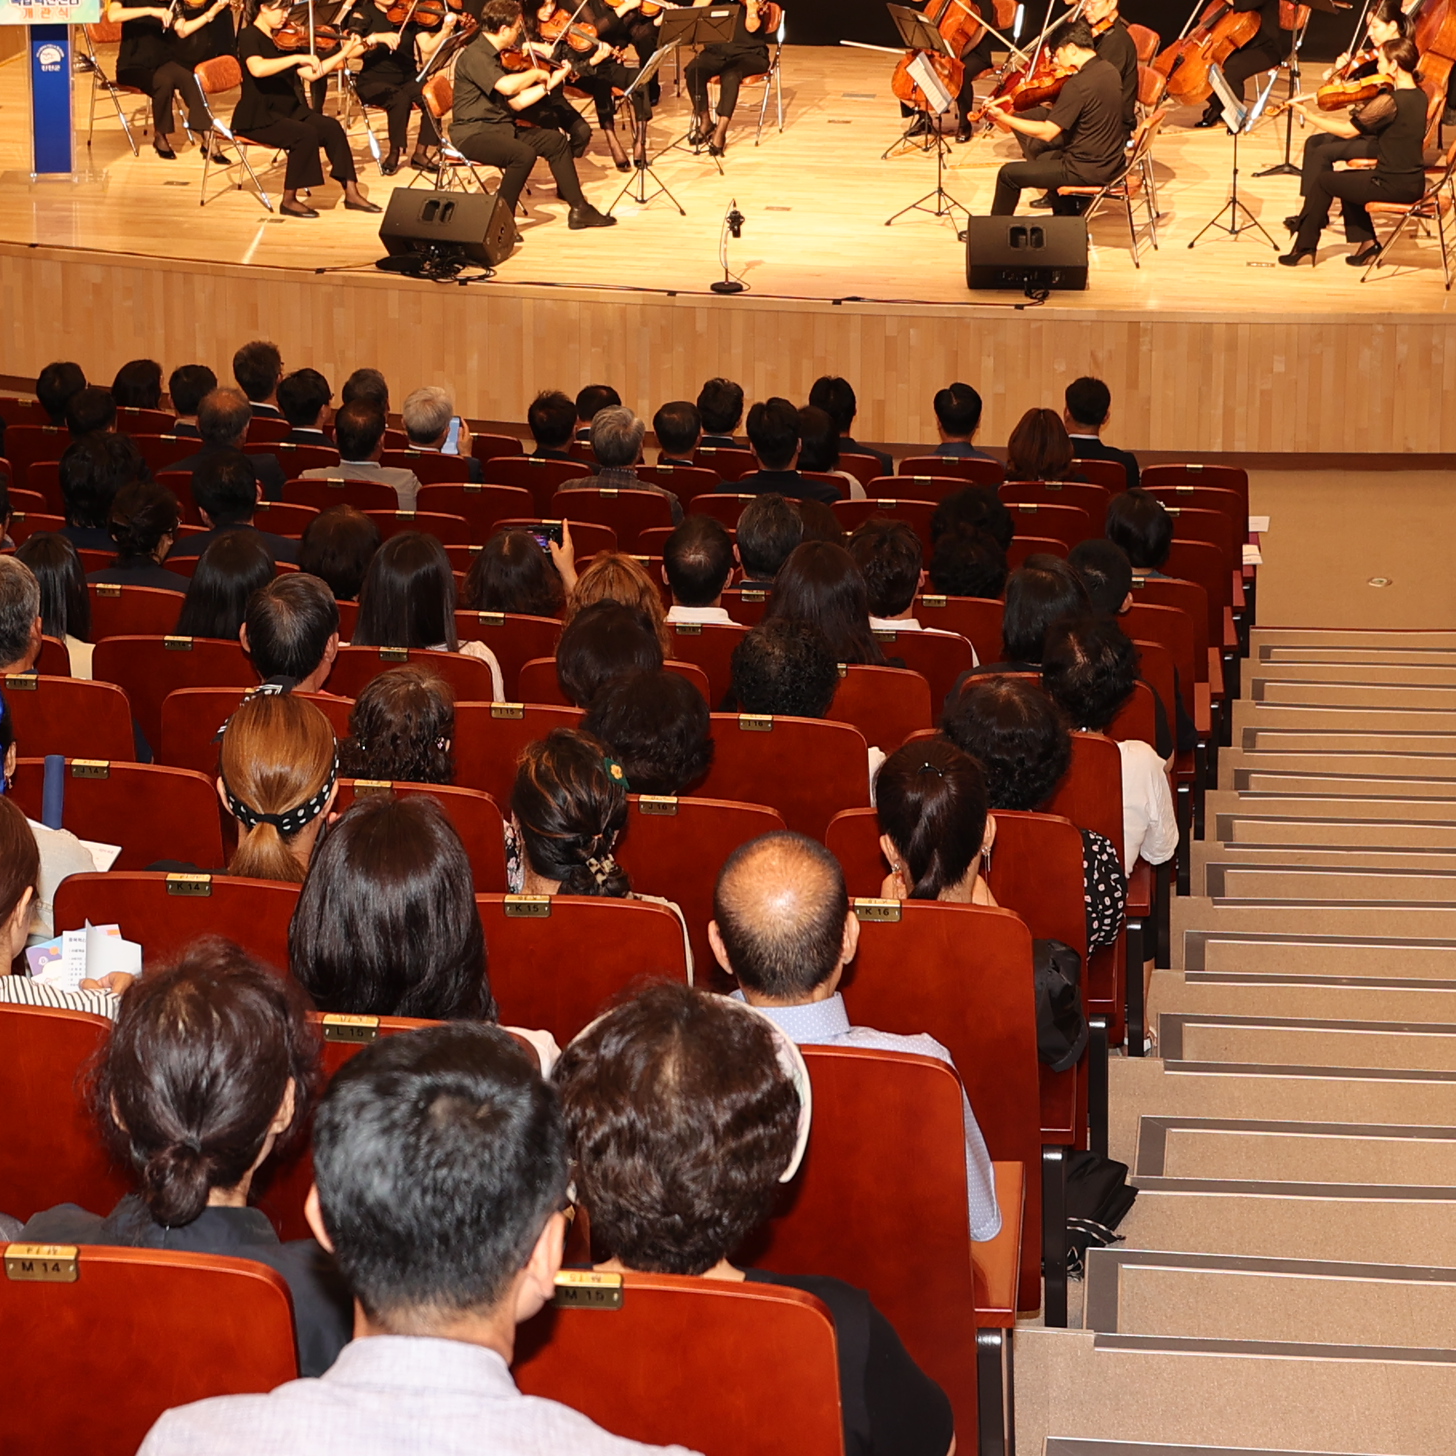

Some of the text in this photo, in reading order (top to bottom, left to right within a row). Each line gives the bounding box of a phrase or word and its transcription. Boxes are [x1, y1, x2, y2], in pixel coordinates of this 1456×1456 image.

[188, 883, 200, 891] 14
[527, 905, 539, 913] 15
[877, 908, 889, 916] 16
[336, 1027, 363, 1037] L 15
[21, 1260, 61, 1273] M 14
[564, 1289, 604, 1302] M 15
